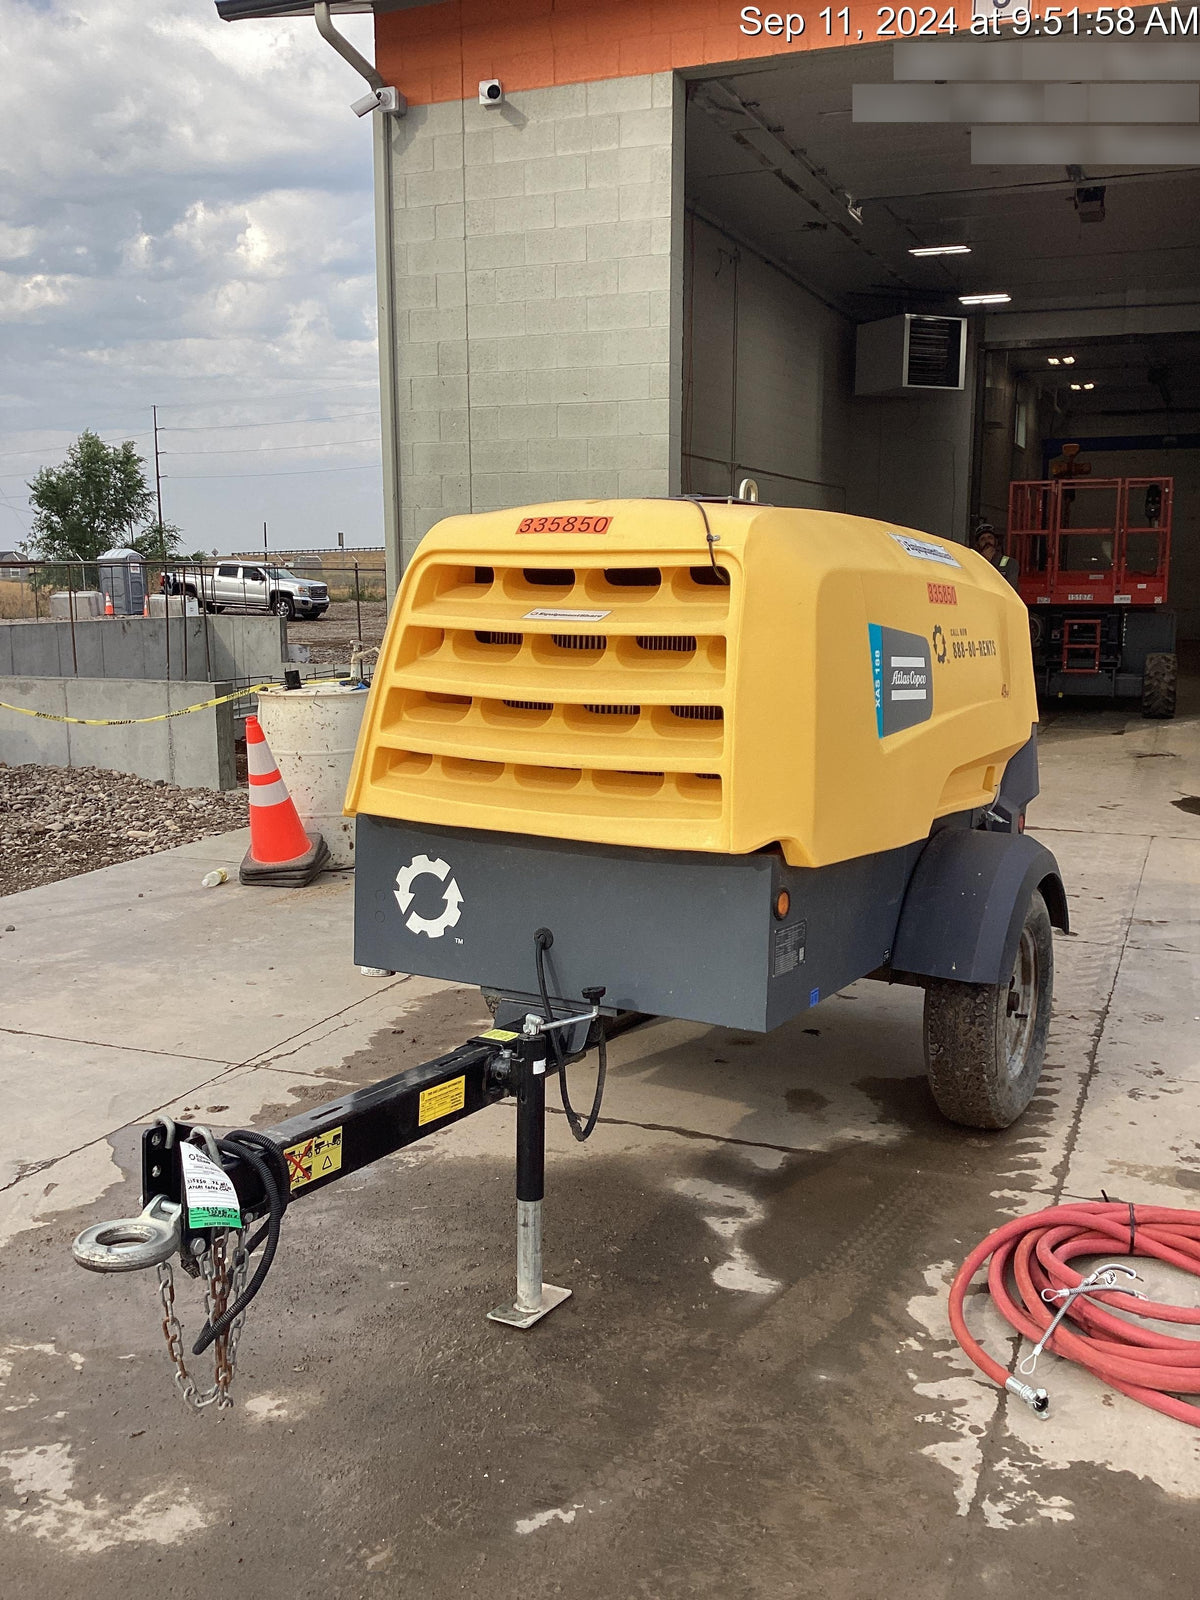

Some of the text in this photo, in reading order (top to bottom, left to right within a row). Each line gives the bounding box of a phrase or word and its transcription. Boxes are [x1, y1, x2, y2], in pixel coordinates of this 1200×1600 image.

[519, 516, 609, 533] 335850
[928, 584, 957, 604] 335850
[952, 639, 997, 659] 888-80-RENTS
